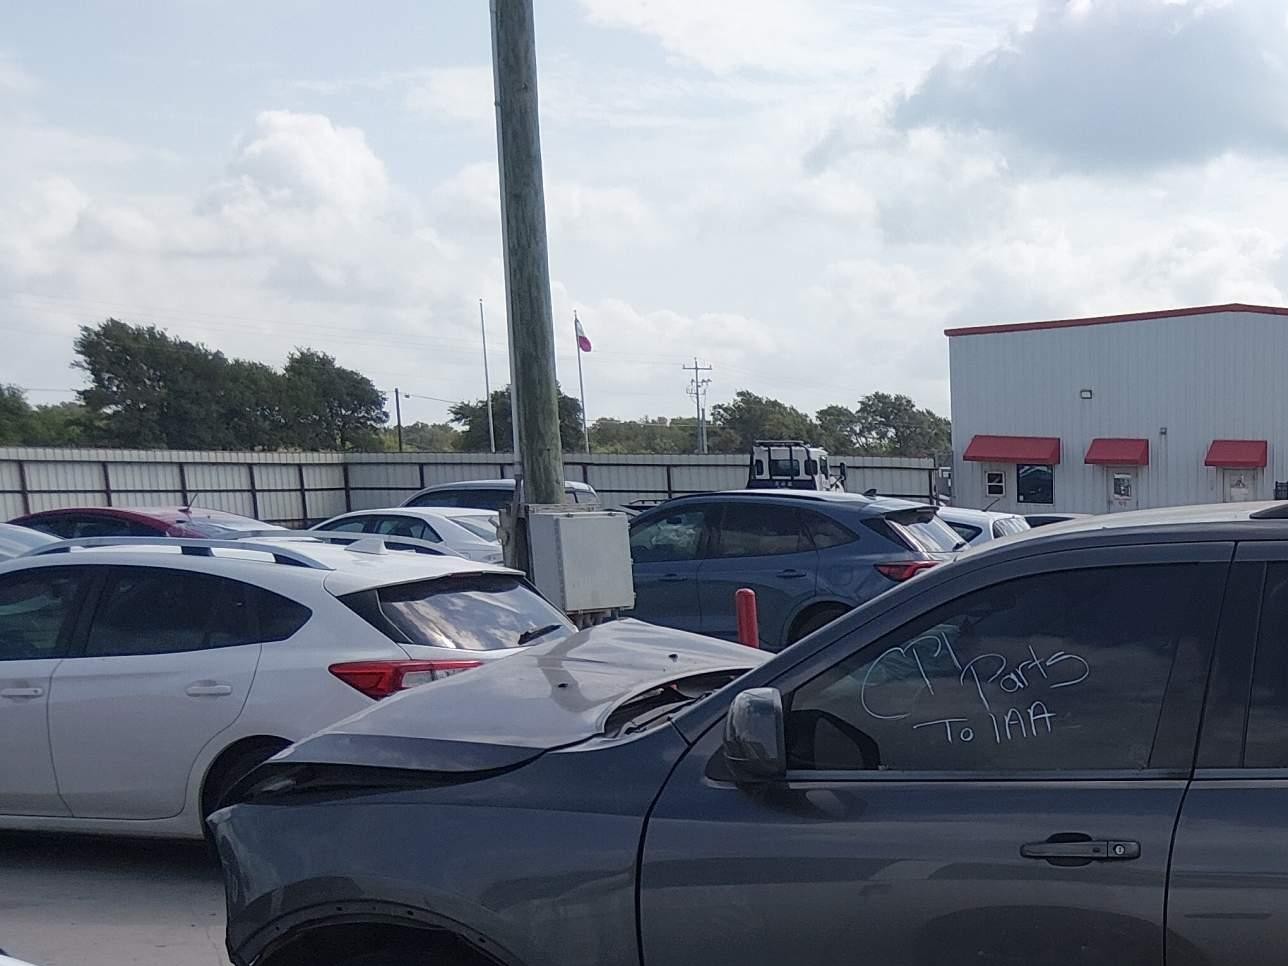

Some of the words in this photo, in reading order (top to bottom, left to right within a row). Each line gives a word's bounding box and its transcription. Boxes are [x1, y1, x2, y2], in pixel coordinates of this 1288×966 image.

[960, 645, 1090, 711] Parts
[913, 718, 974, 744] To
[989, 701, 1056, 744] IAA
